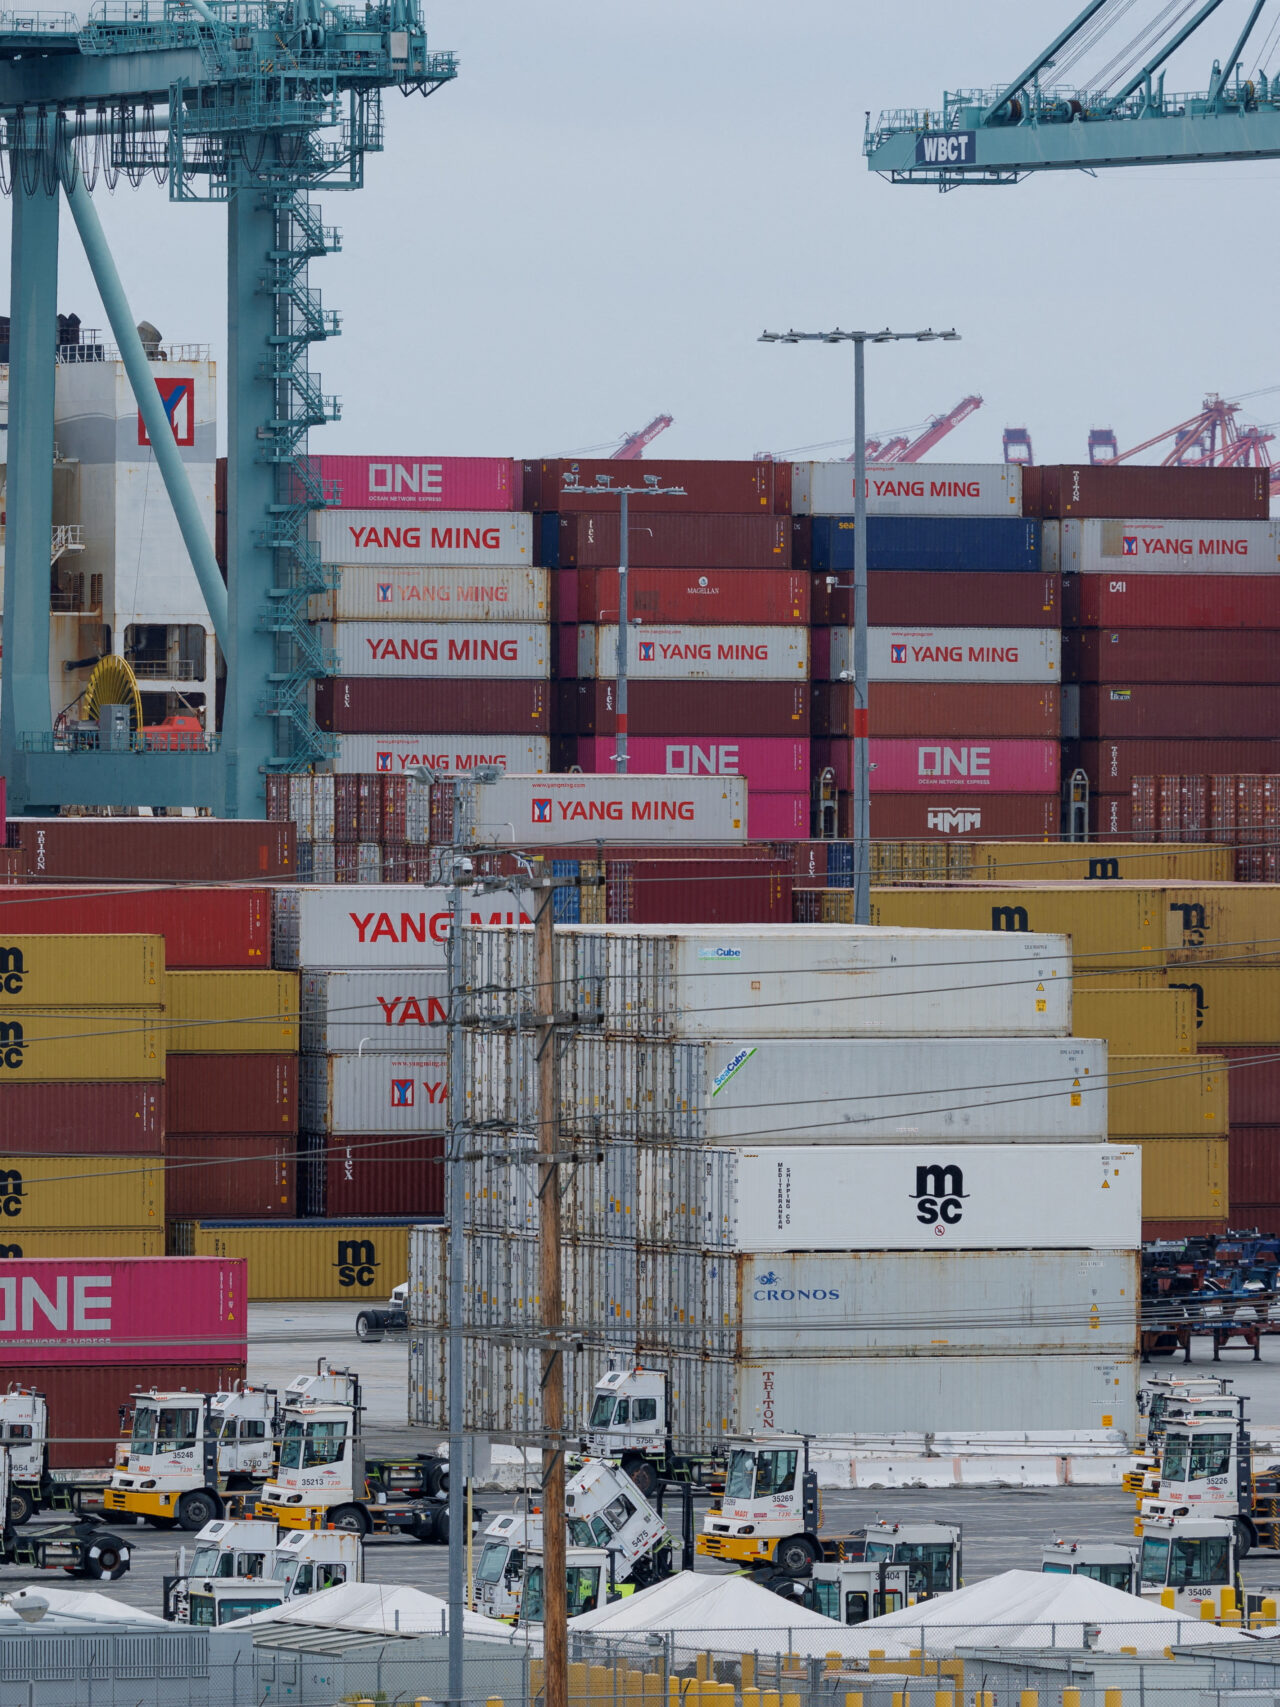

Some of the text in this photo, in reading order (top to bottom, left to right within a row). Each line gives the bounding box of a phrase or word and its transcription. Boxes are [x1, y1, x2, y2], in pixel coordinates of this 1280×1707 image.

[923, 135, 969, 162] WBCT
[369, 464, 442, 493] ONE
[873, 481, 980, 498] YANG MING
[839, 522, 855, 530] sea
[349, 527, 500, 549] YANG MING
[1142, 538, 1248, 555] YANG MING
[398, 584, 508, 602] YANG MING
[687, 587, 720, 595] MAGELLAN
[1109, 581, 1126, 592] CAI
[366, 638, 518, 661] YANG MING
[659, 644, 768, 660] YANG MING
[911, 646, 1019, 662] YANG MING
[397, 754, 507, 770] YANG MING
[666, 745, 739, 774] ONE
[918, 747, 990, 776] ONE
[558, 801, 694, 821] YANG MING
[927, 807, 981, 833] HMM
[37, 830, 46, 870] TRITON
[376, 996, 448, 1027] YAN
[392, 1059, 448, 1067] www.yangming.co
[713, 1049, 748, 1087] SeaCube
[423, 1082, 448, 1105] YA
[344, 1145, 354, 1181] tex
[786, 1214, 791, 1225] CO
[754, 1288, 840, 1301] CRONOS
[762, 1371, 775, 1428] TRITON
[172, 1451, 193, 1459] 35248
[301, 1478, 324, 1486] 35213
[1206, 1477, 1228, 1485] 35226
[772, 1494, 794, 1502] 35269
[631, 1530, 649, 1548] 5475
[875, 1572, 900, 1581] 3404
[1188, 1588, 1212, 1596] 35406
